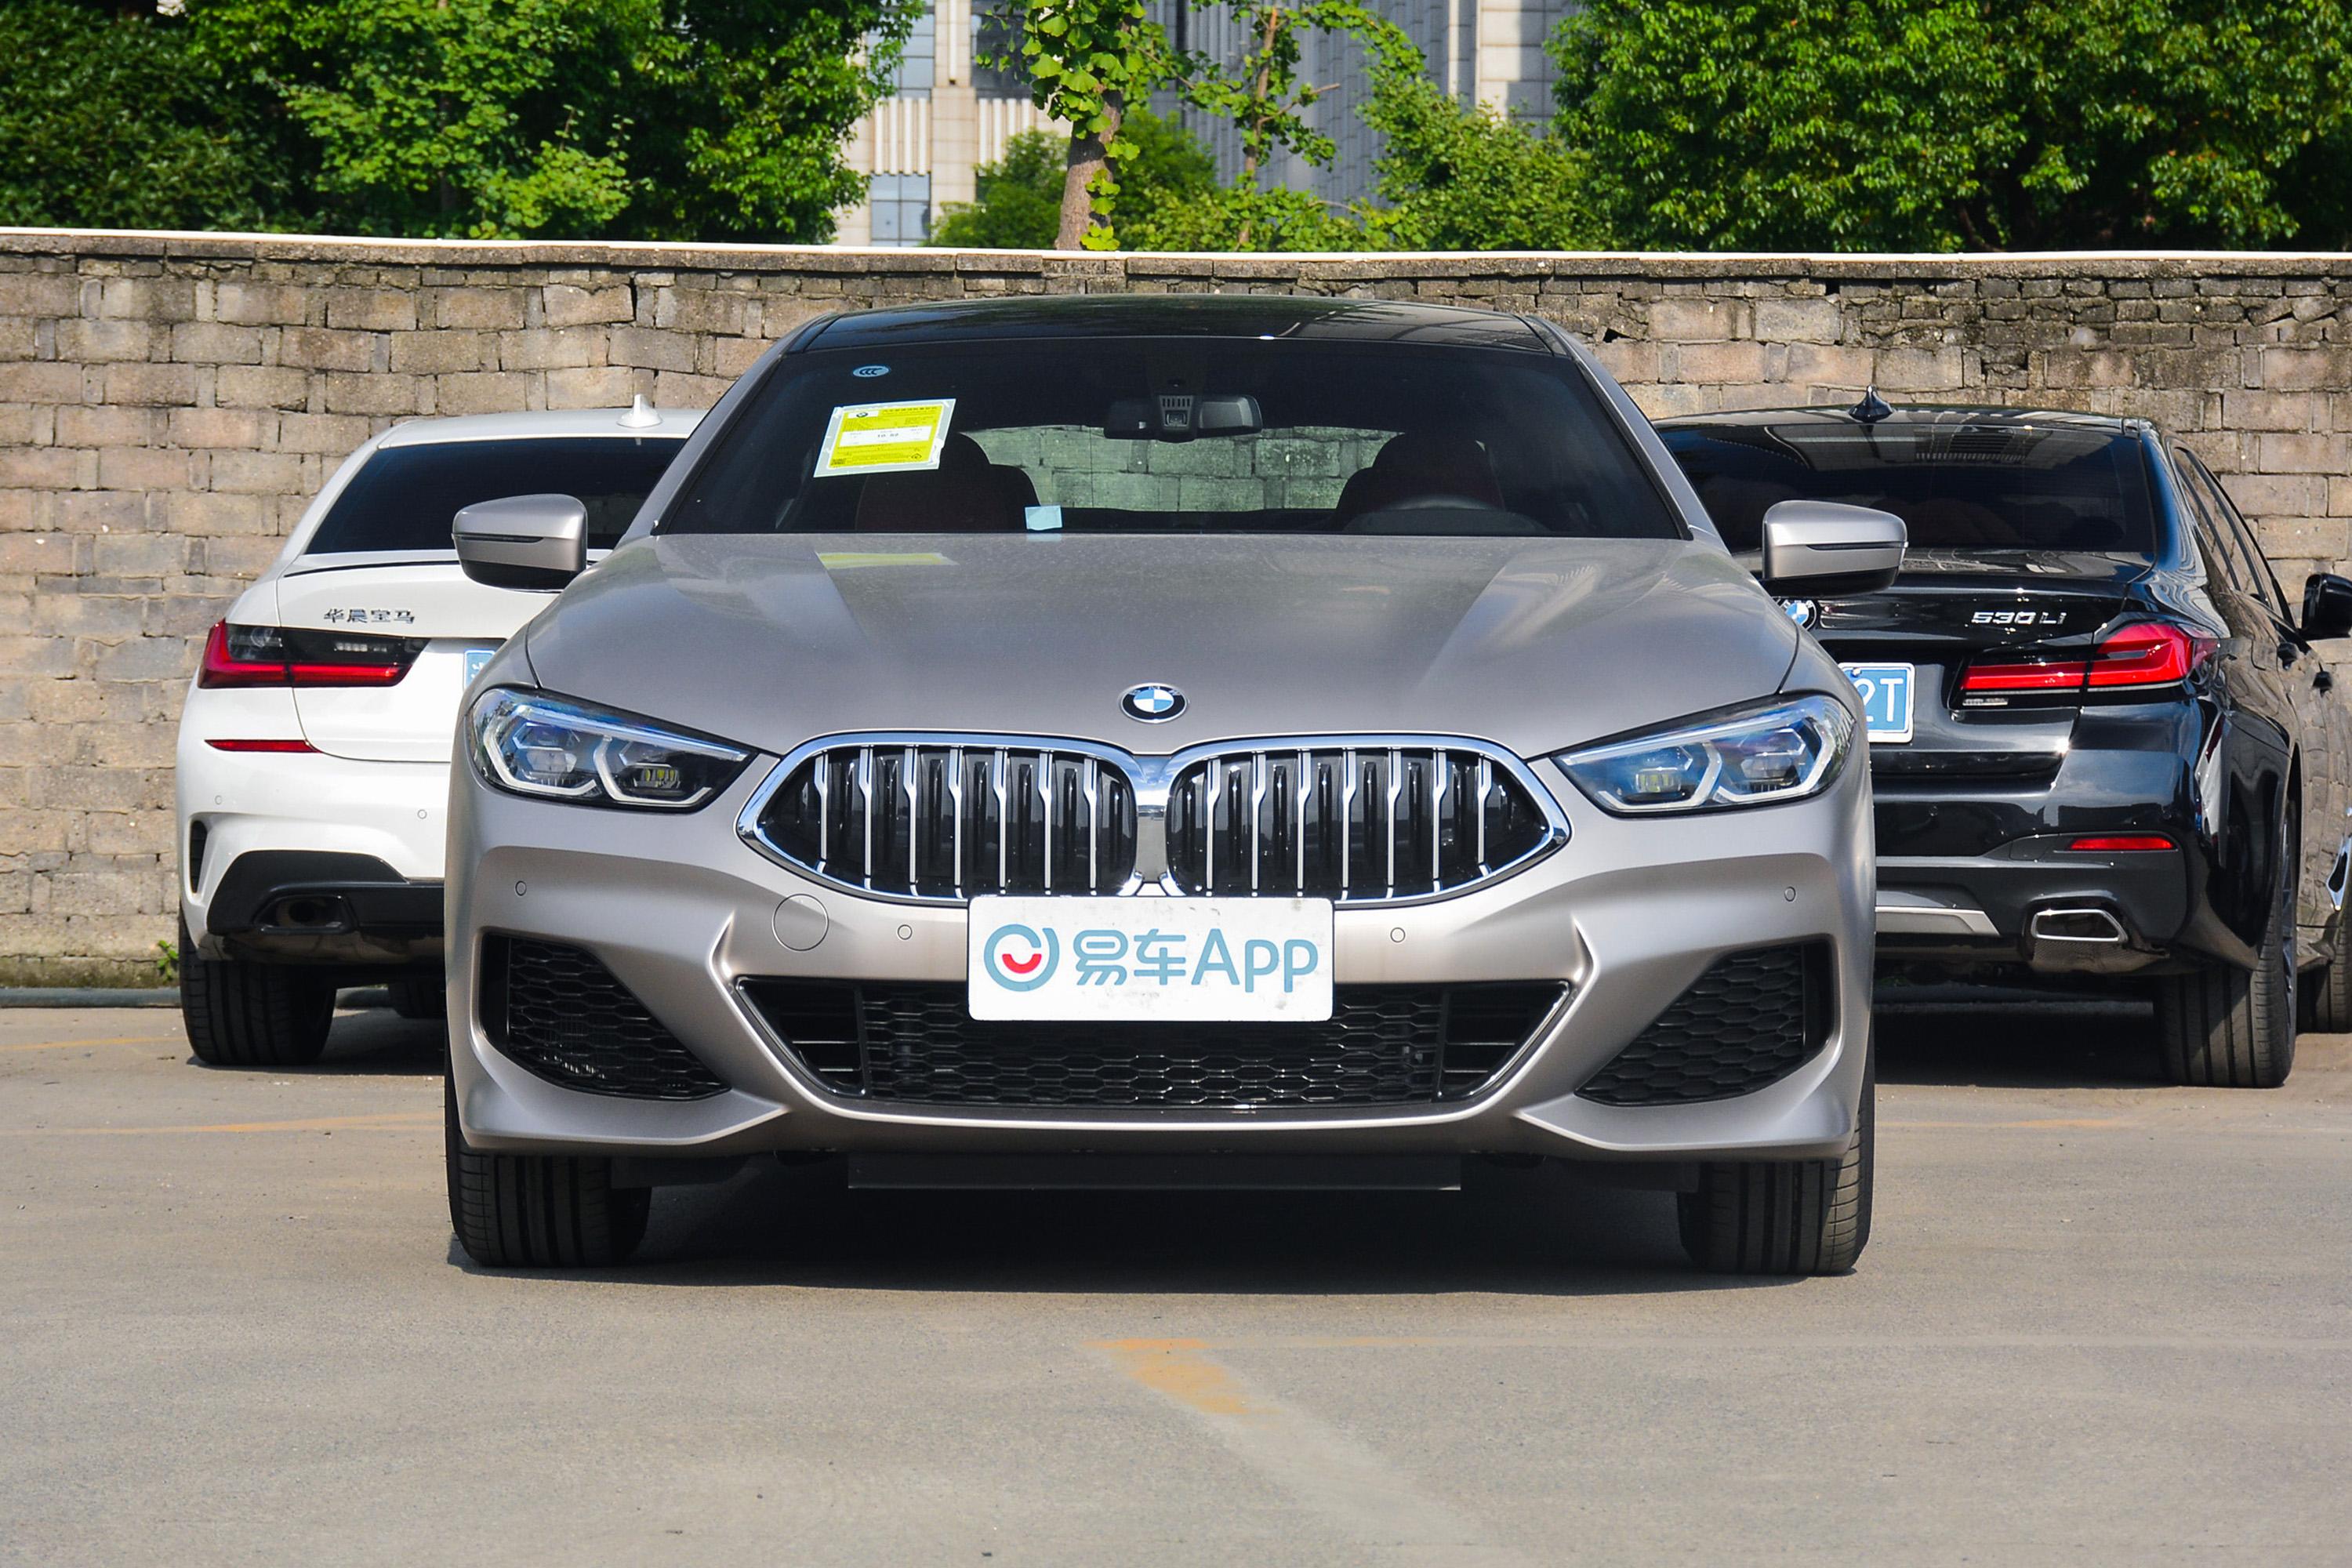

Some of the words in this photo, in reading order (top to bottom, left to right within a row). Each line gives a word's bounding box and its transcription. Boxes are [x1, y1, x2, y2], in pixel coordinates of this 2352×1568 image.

[323, 608, 415, 624] 华晨宝马
[1073, 927, 1319, 993] 易车App
